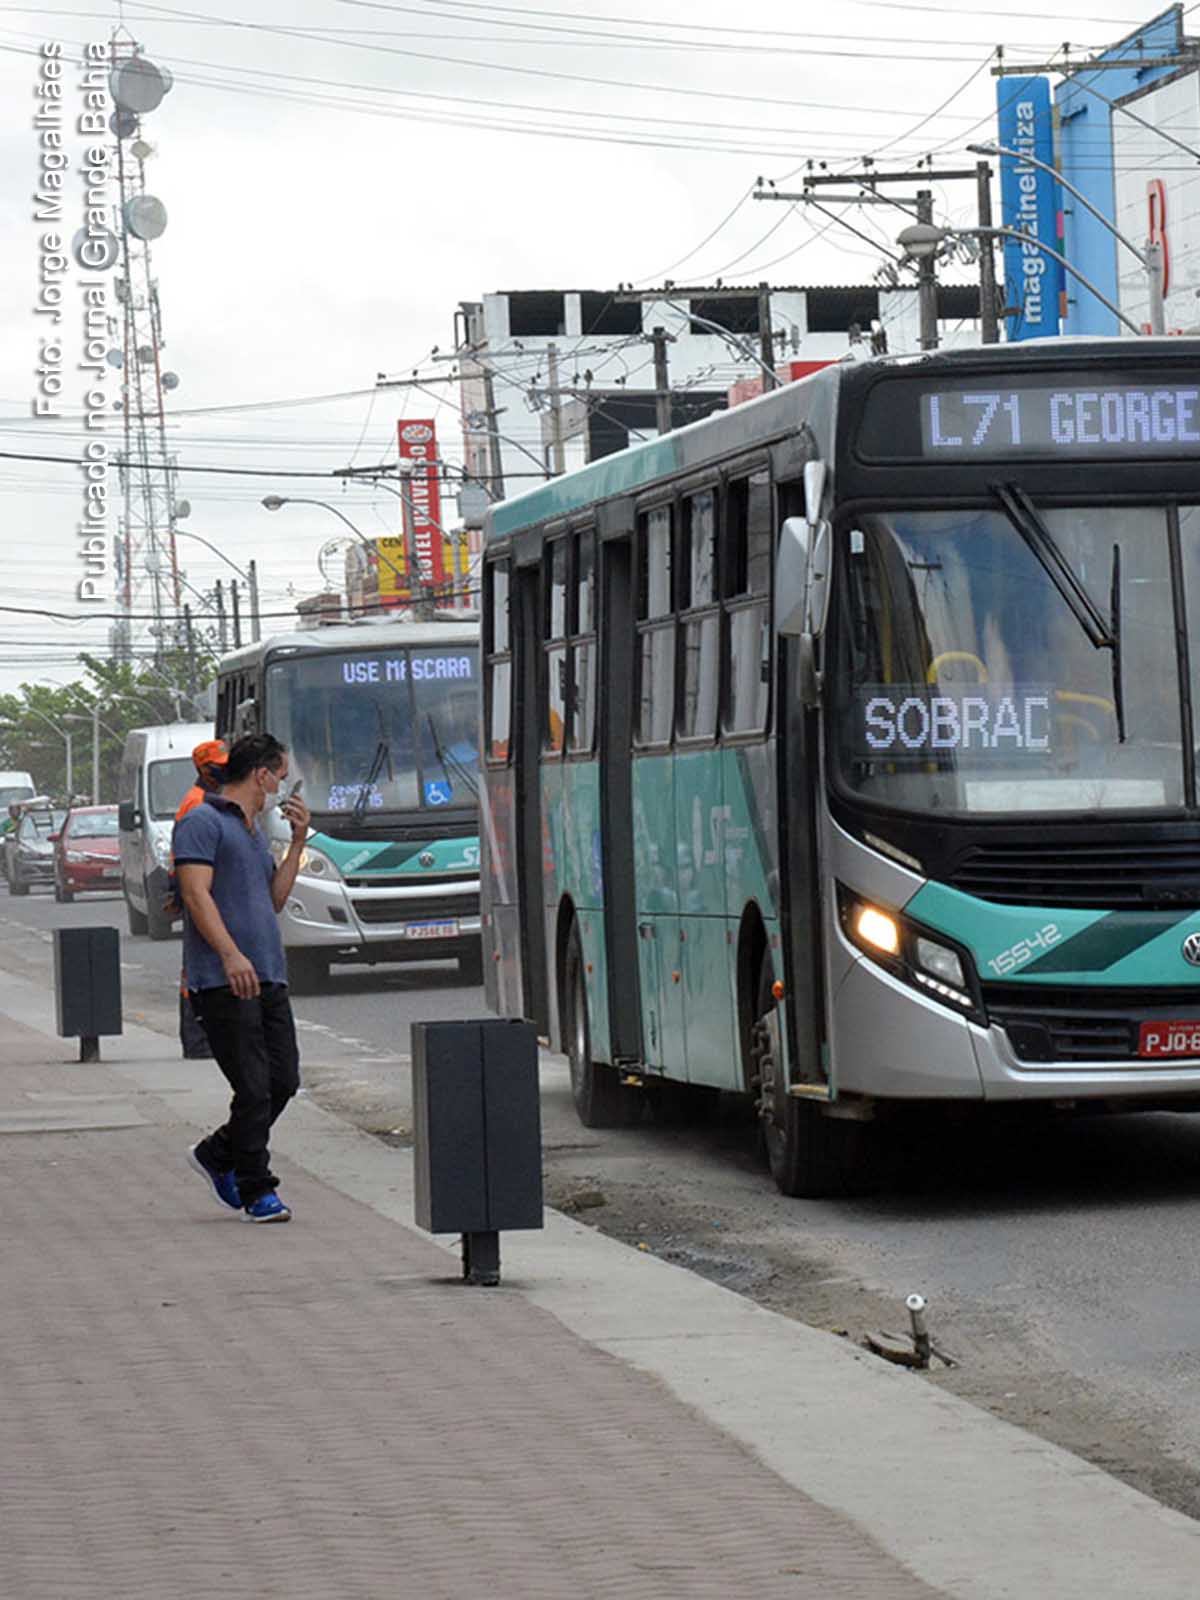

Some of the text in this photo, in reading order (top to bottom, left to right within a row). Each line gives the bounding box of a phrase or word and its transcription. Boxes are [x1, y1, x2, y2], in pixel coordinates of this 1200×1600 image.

[1013, 101, 1046, 325] magazineluiza
[930, 394, 1022, 445] L71
[1049, 391, 1200, 444] GEORGE
[343, 662, 379, 683] USE
[987, 923, 1062, 977] 15542
